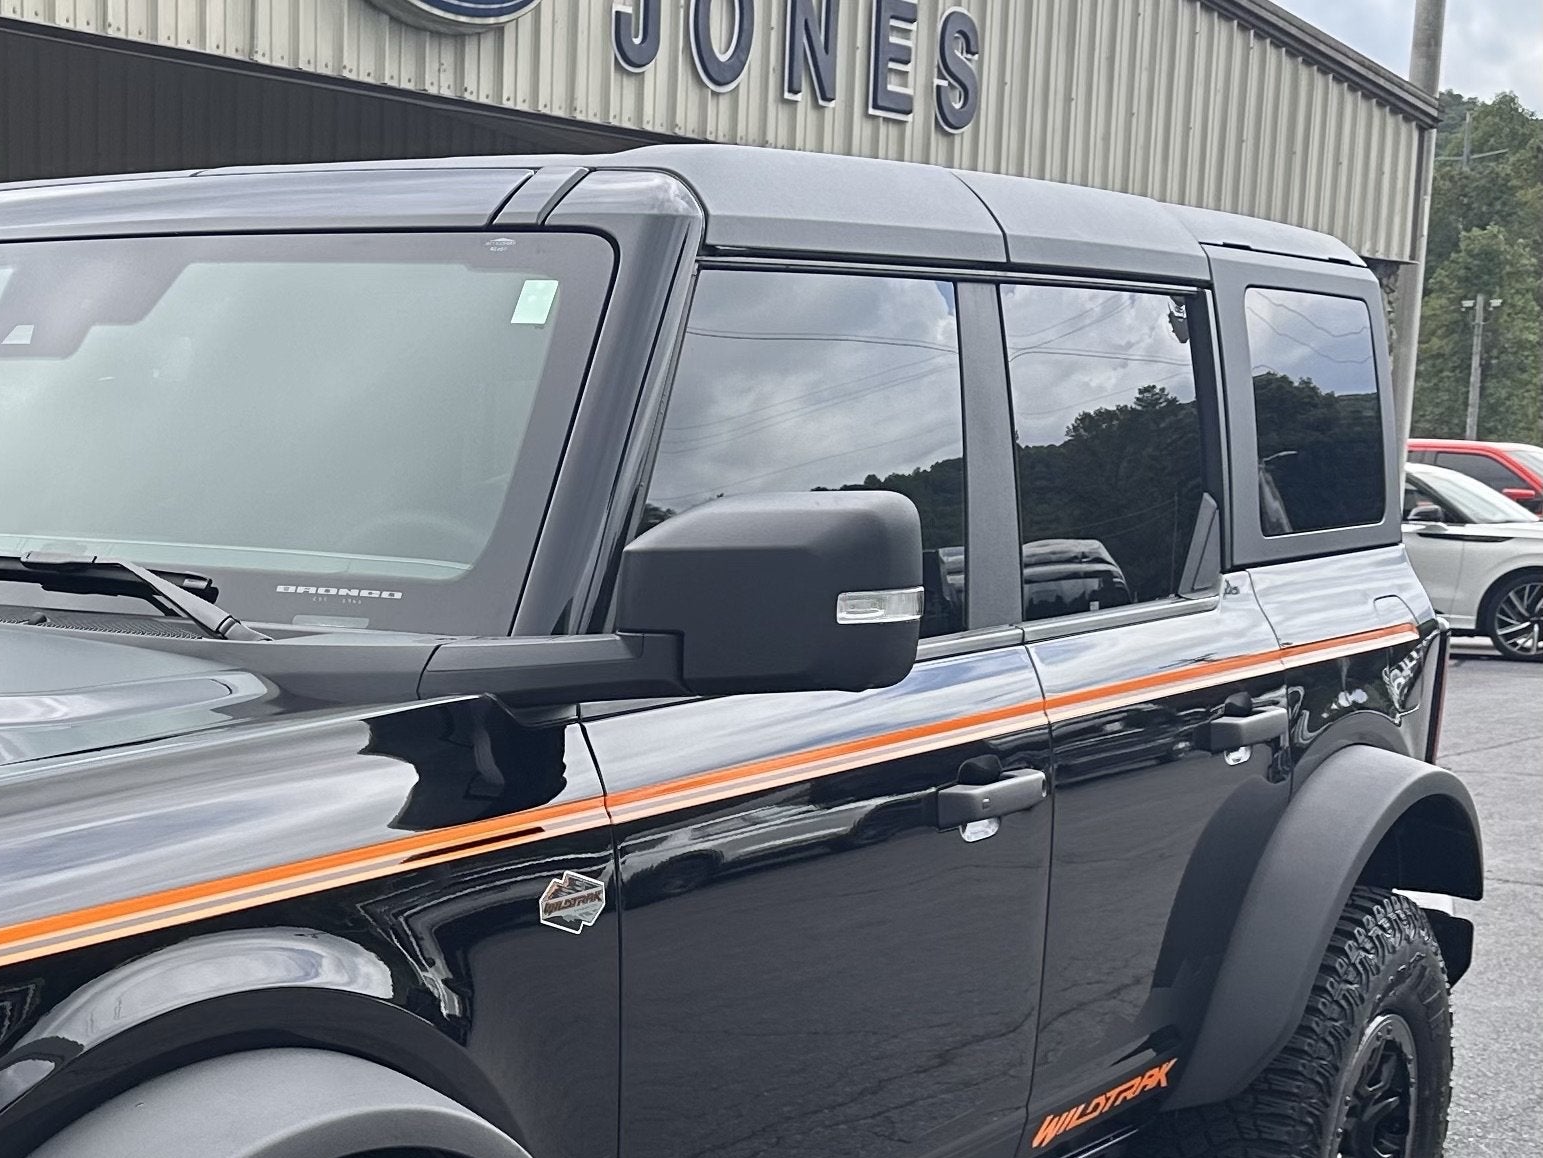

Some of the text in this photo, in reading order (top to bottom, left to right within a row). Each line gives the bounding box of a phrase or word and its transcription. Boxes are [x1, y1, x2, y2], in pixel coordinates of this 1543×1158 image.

[611, 0, 981, 134] JONES
[276, 585, 403, 600] BRONCO
[1031, 1057, 1178, 1149] WILDTRAK
